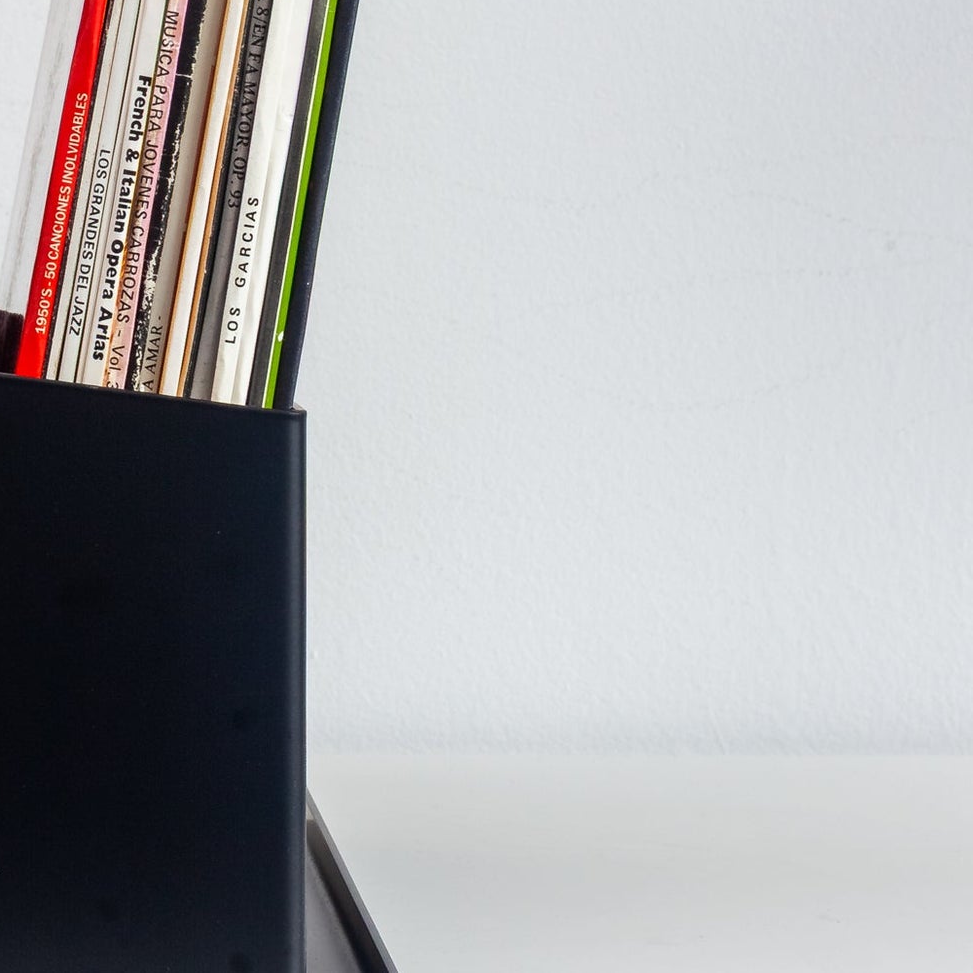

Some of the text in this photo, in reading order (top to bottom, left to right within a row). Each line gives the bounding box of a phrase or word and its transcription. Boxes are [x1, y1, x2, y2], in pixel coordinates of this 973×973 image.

[156, 10, 180, 77] MUSICA
[148, 84, 168, 133] PARA
[35, 92, 89, 336] 1950'S 50 CANCIONES INOLVIDABLES
[93, 75, 151, 362] French & Italian Opera Arias
[134, 138, 159, 220] JOVENES
[227, 189, 242, 209] 93
[69, 149, 111, 336] LOS GRANDES DEL JAZZ
[117, 225, 144, 324] CARROZAS
[225, 197, 259, 344] LOS GARCIAS
[107, 345, 126, 375] Vol.
[145, 326, 164, 375] AMAR
